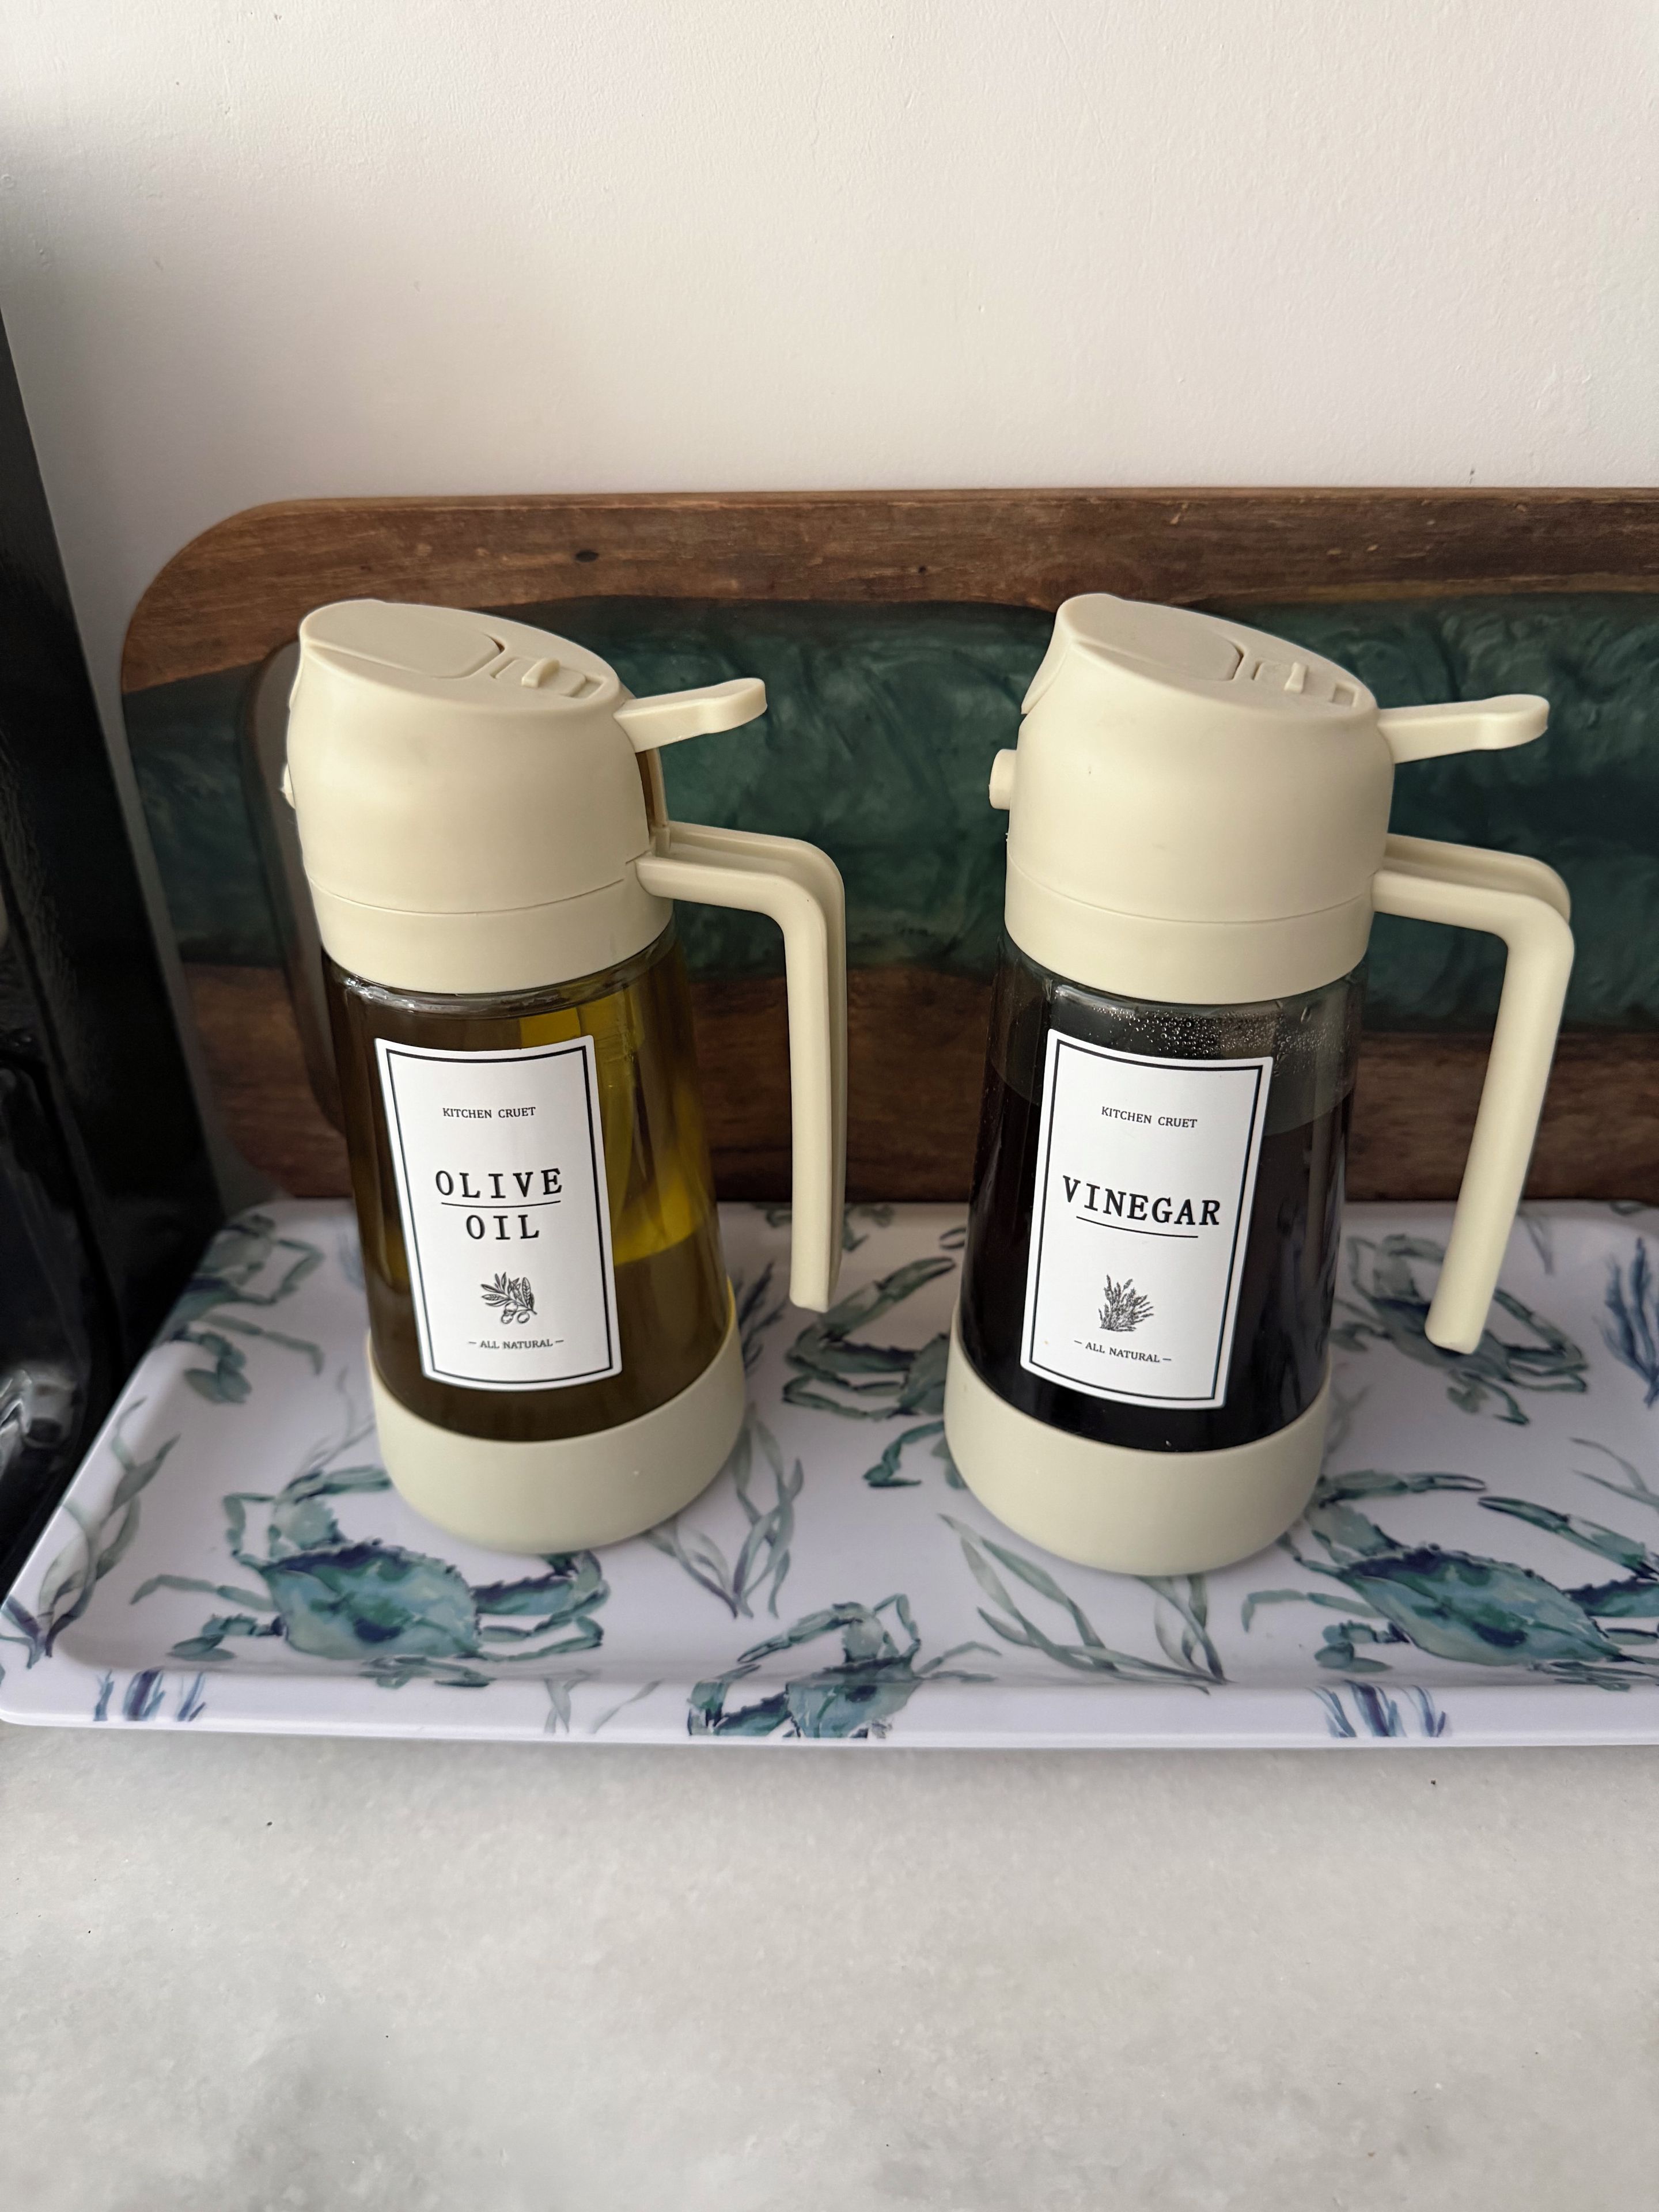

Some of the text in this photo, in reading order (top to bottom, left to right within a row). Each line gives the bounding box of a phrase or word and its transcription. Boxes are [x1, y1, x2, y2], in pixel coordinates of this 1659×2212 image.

[442, 1106, 536, 1119] KITCHEN CRUET
[1101, 1106, 1198, 1128] KITCHEN CRUET
[435, 1168, 563, 1199] OLIVE
[1062, 1175, 1221, 1226] VINEGAR
[465, 1214, 540, 1240] OIL
[480, 1338, 554, 1349] ALL NATURAL
[1085, 1342, 1160, 1363] ALL NATURAL
